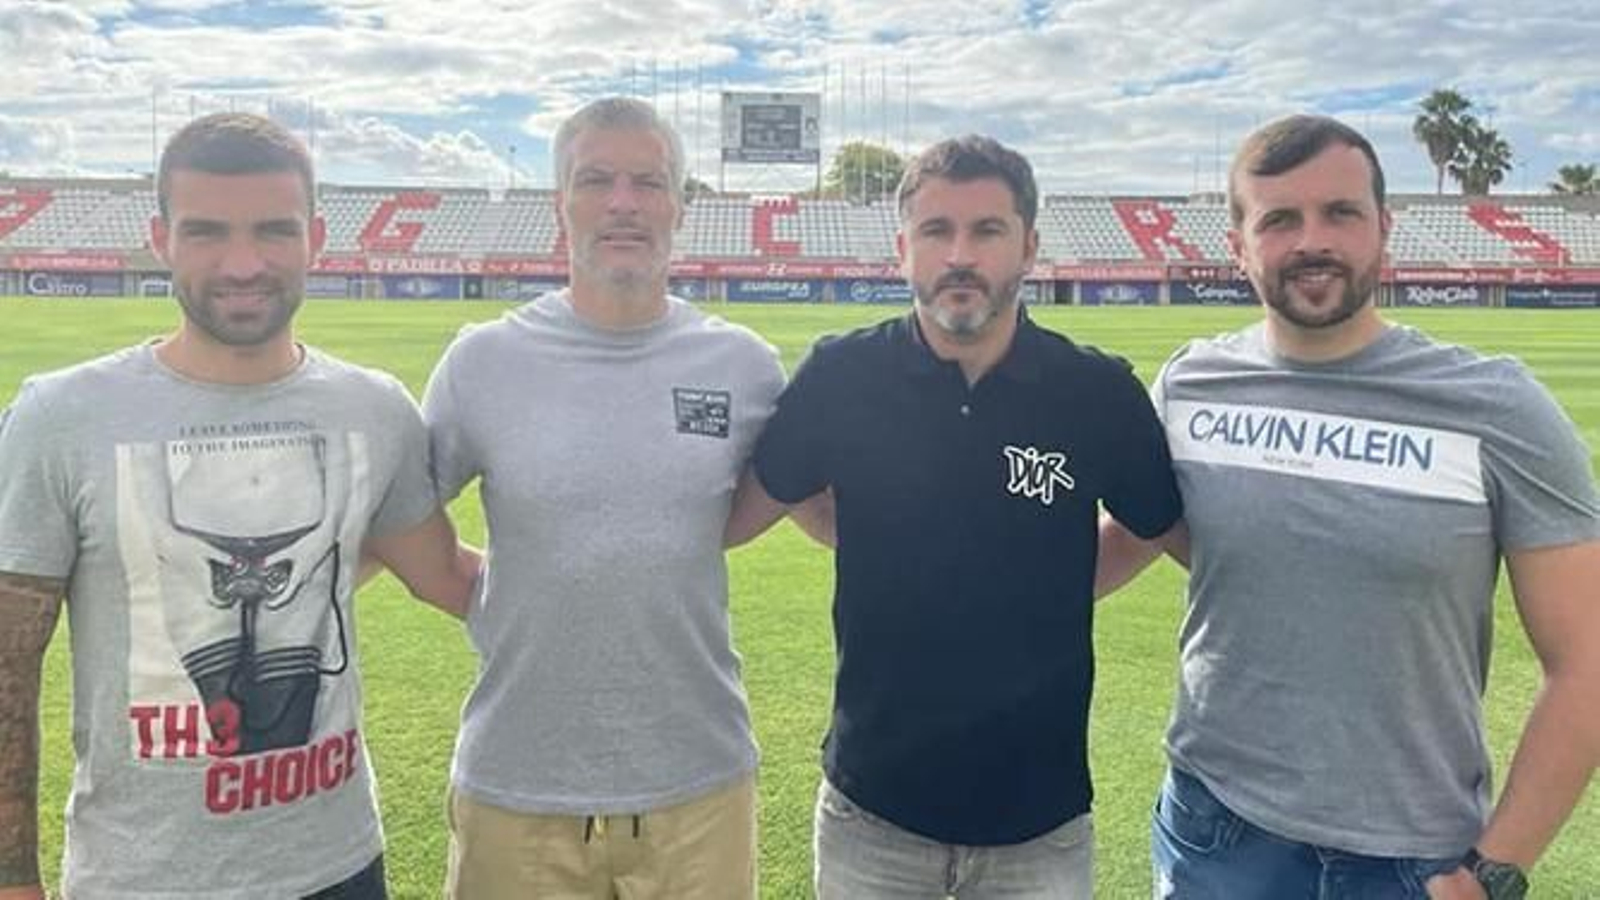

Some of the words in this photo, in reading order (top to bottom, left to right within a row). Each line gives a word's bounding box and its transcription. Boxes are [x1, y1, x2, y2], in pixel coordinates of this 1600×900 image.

[1112, 200, 1204, 261] R
[387, 258, 463, 273] PADILLA
[171, 442, 192, 455] TO
[1189, 409, 1306, 455] CALVIN
[1315, 421, 1434, 471] KLEIN
[130, 696, 240, 759] TH3
